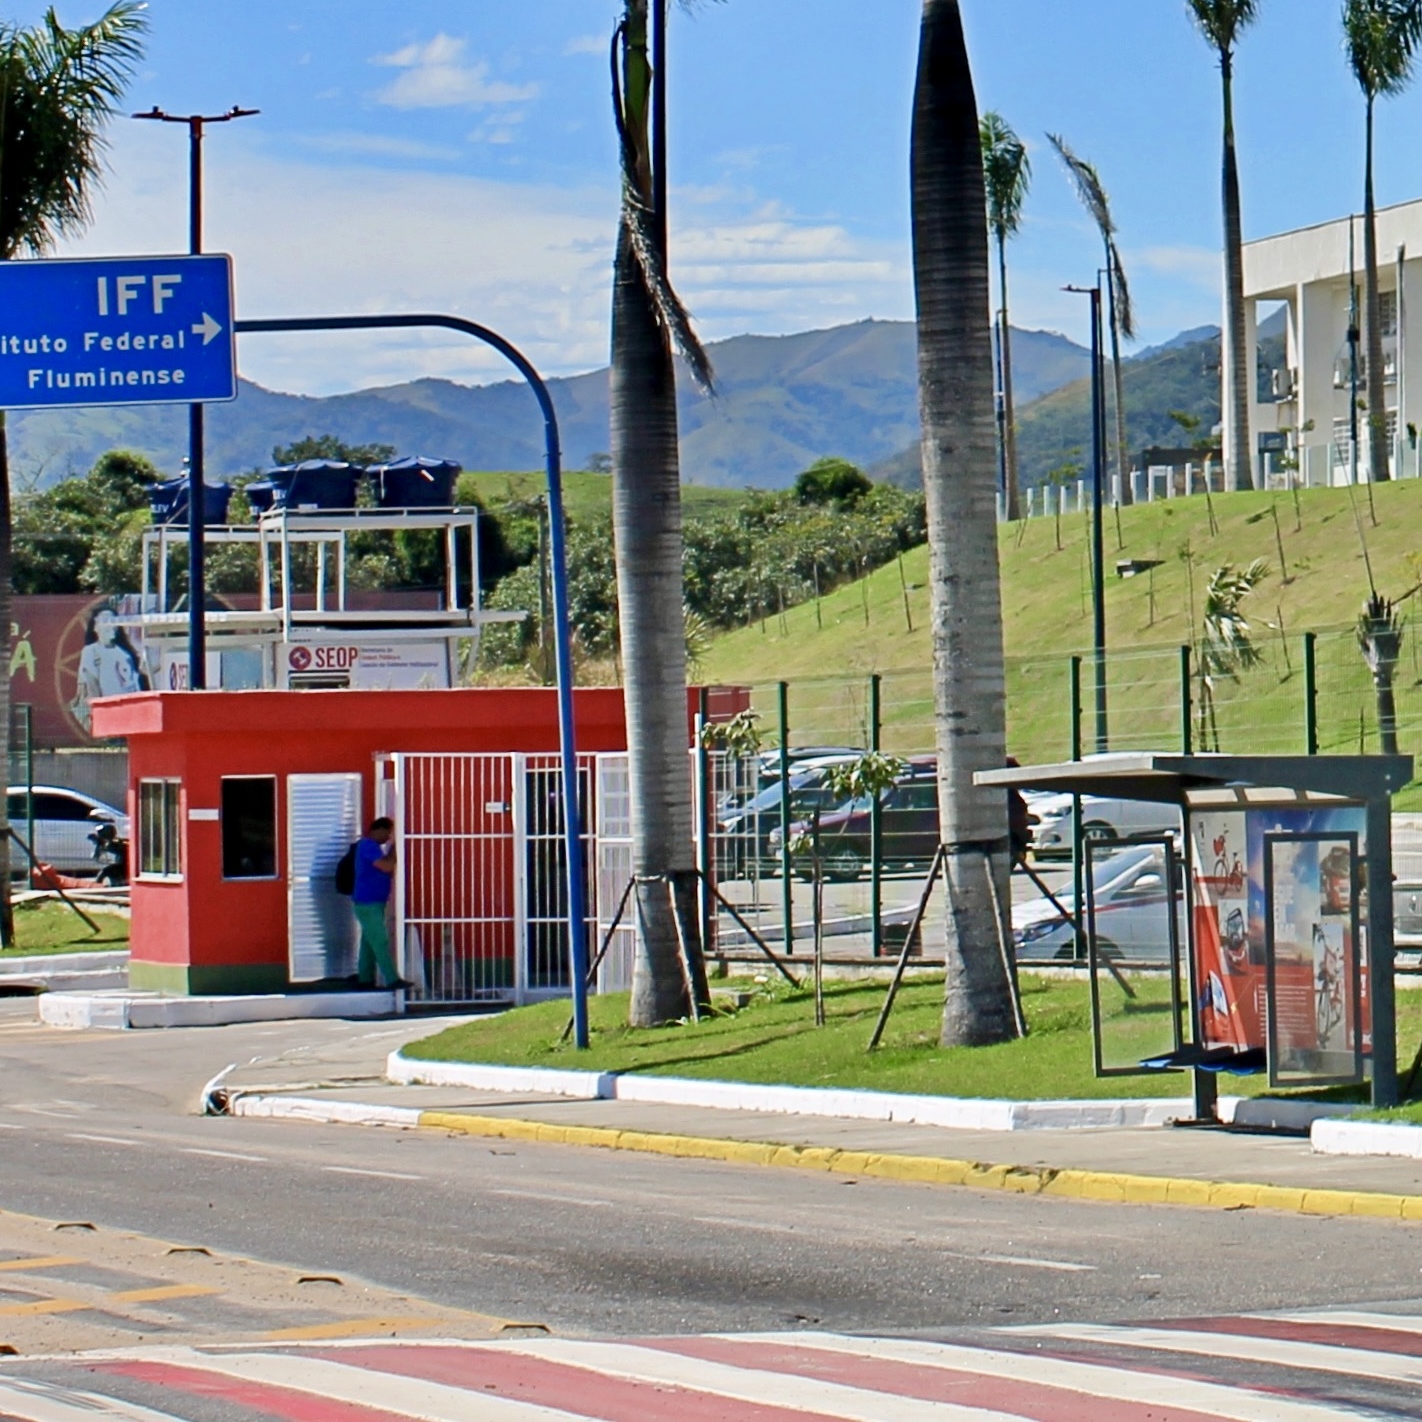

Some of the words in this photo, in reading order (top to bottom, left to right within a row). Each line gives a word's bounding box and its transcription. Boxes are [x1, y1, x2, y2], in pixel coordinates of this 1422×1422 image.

[97, 274, 182, 316] IFF
[1, 335, 67, 355] ituto
[84, 330, 184, 352] Federal
[28, 368, 186, 389] Fluminense
[315, 646, 358, 668] SEOP
